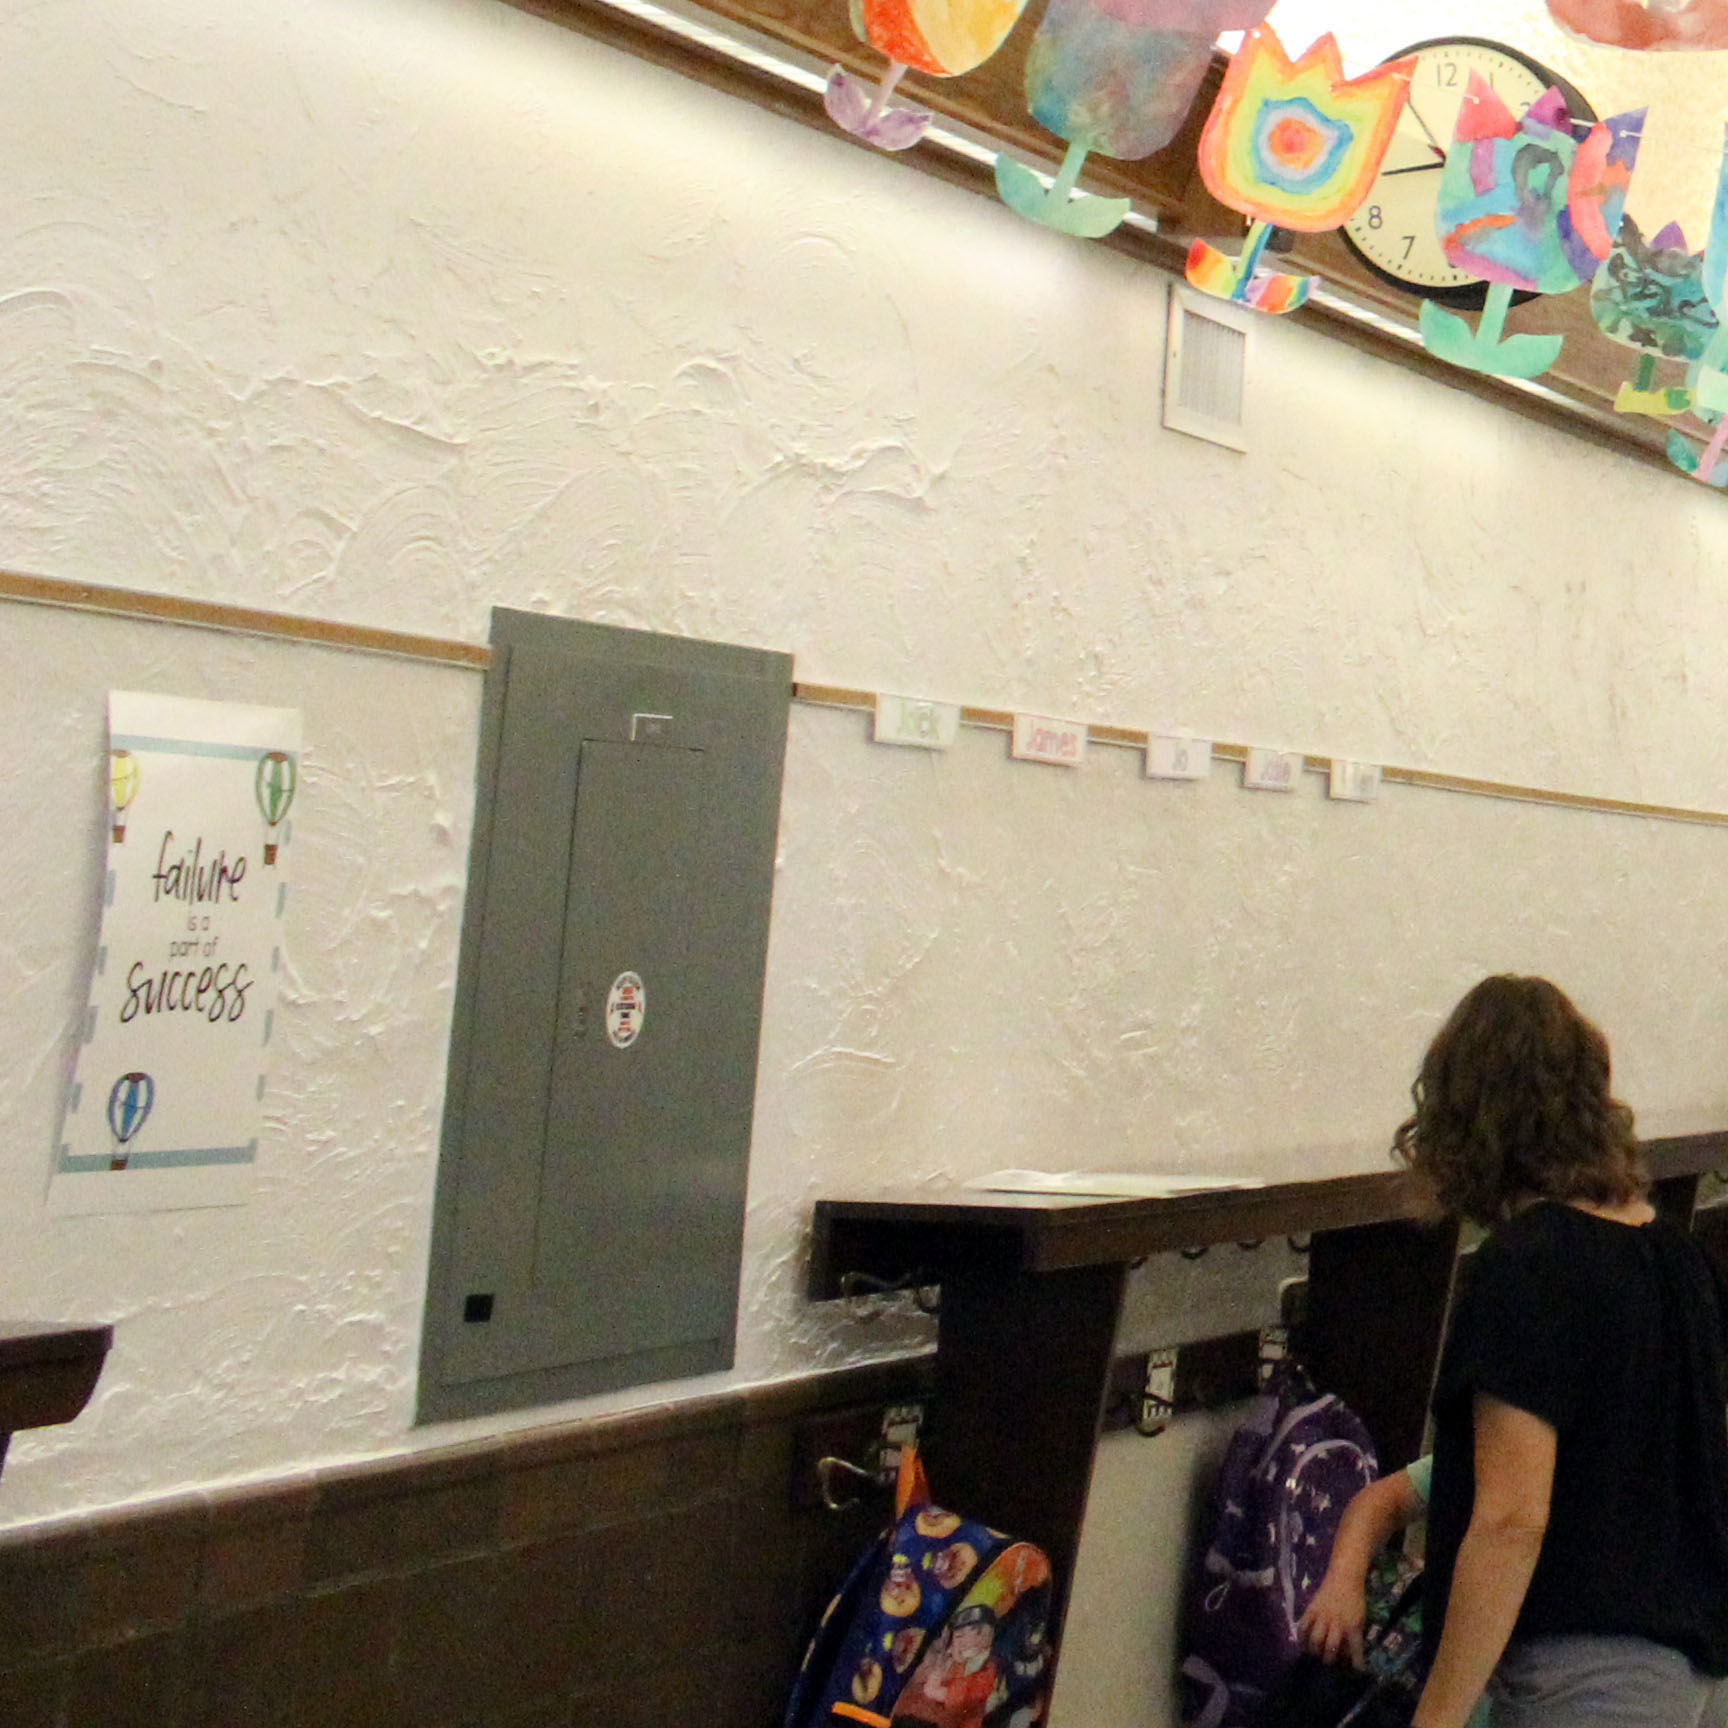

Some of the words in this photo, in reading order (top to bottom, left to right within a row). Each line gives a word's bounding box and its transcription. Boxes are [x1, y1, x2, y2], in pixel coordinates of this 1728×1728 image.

[1436, 62, 1458, 87] 12
[1367, 204, 1384, 230] 8
[1401, 234, 1416, 260] 7
[152, 830, 247, 905] failure
[169, 937, 199, 962] part
[203, 936, 219, 958] of
[120, 960, 255, 1023] success
